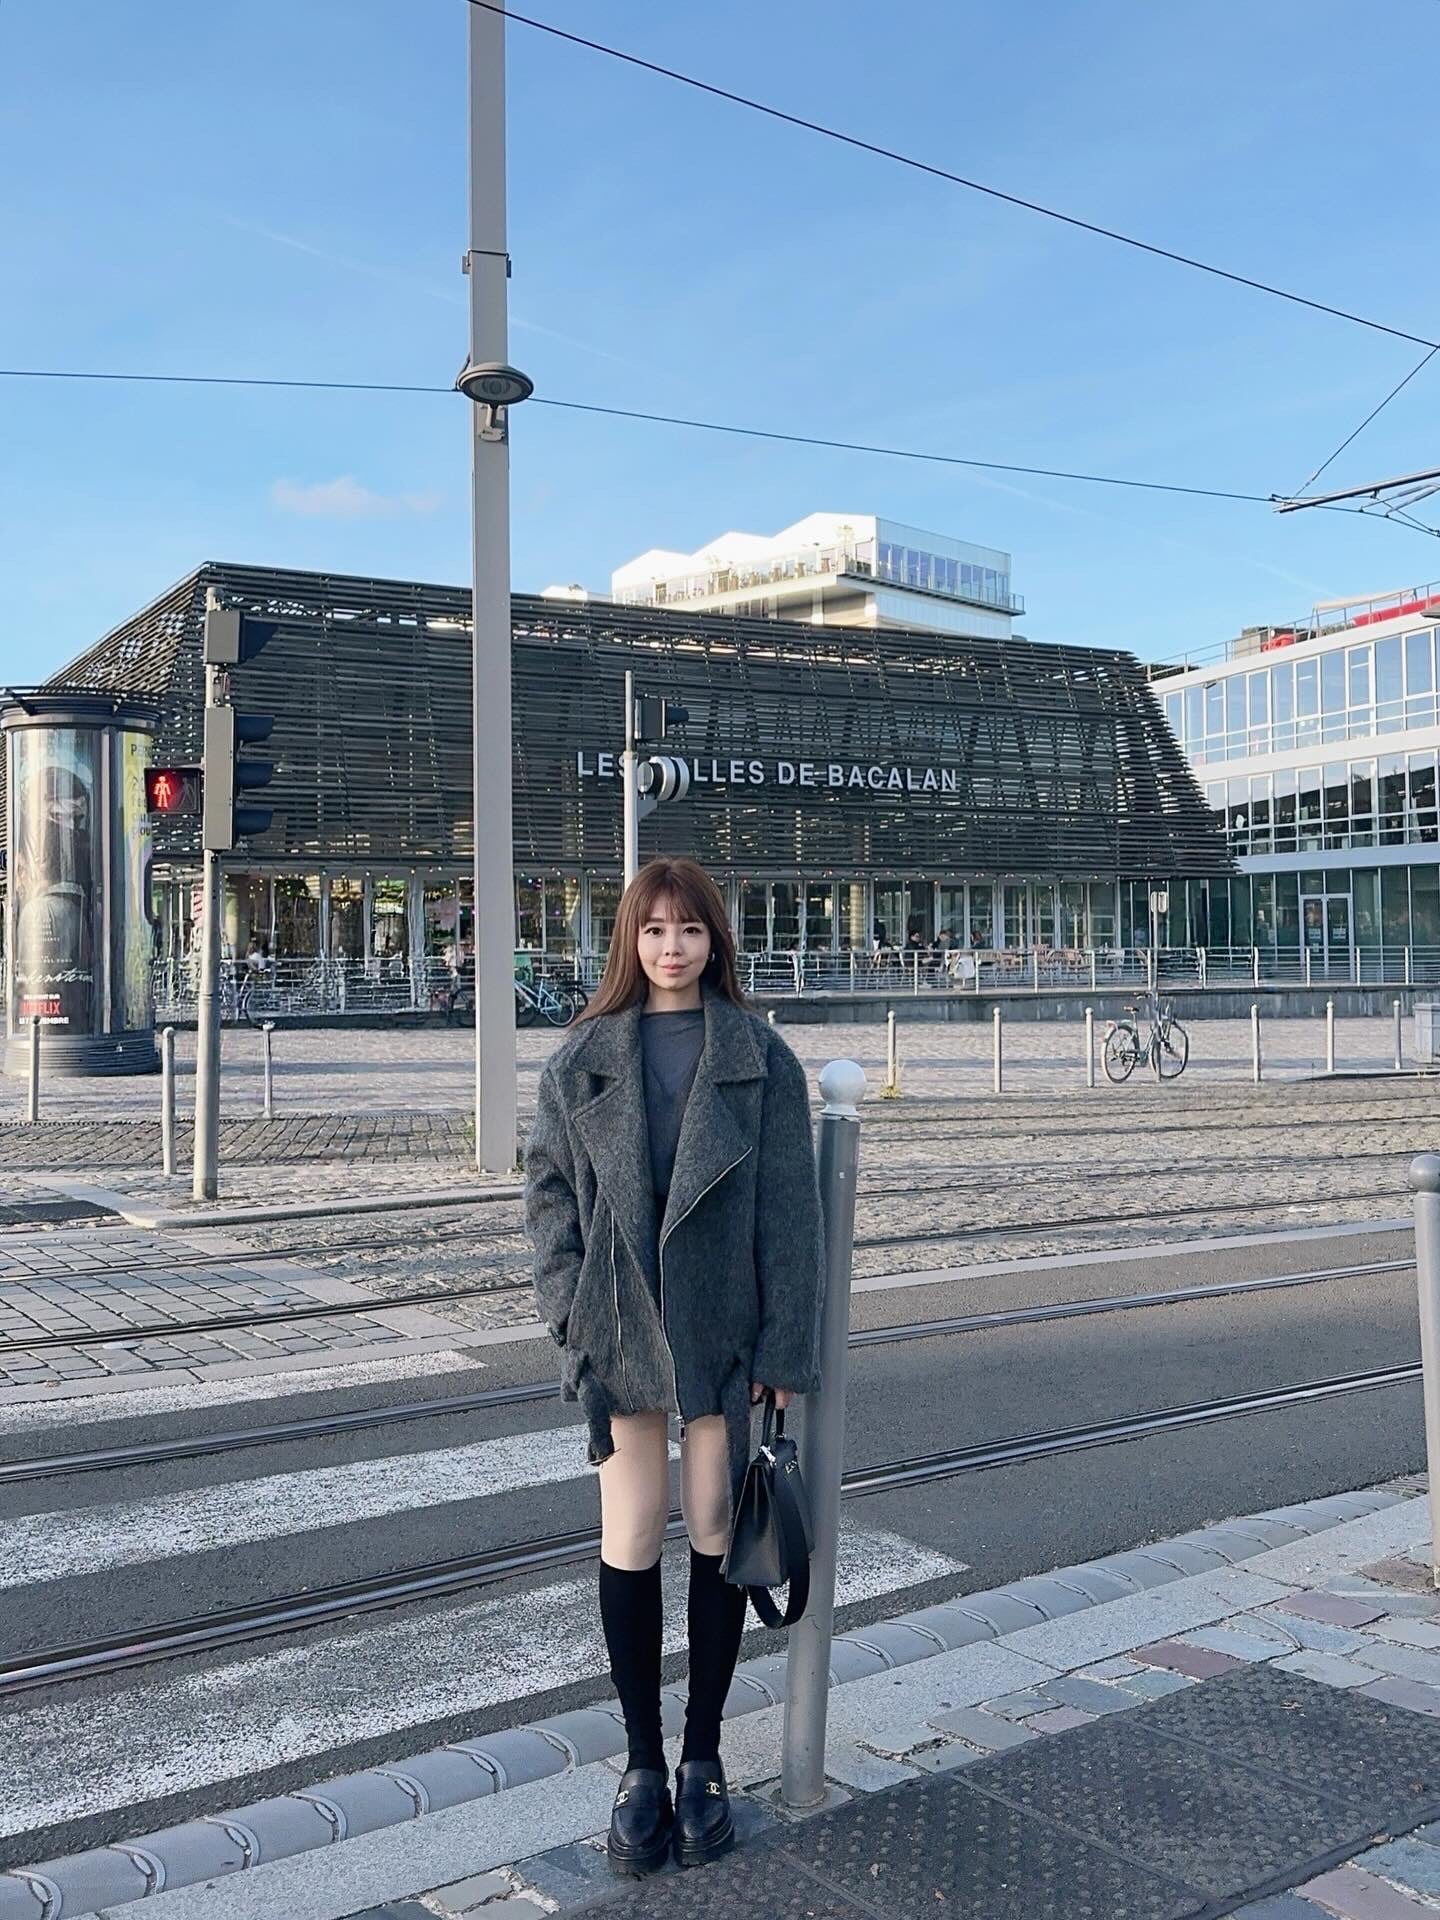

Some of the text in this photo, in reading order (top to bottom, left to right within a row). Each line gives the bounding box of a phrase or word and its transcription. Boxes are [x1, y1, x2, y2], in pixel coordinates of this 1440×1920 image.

[693, 758, 764, 785] LLES
[777, 761, 815, 787] DE
[828, 764, 956, 792] BACALAN
